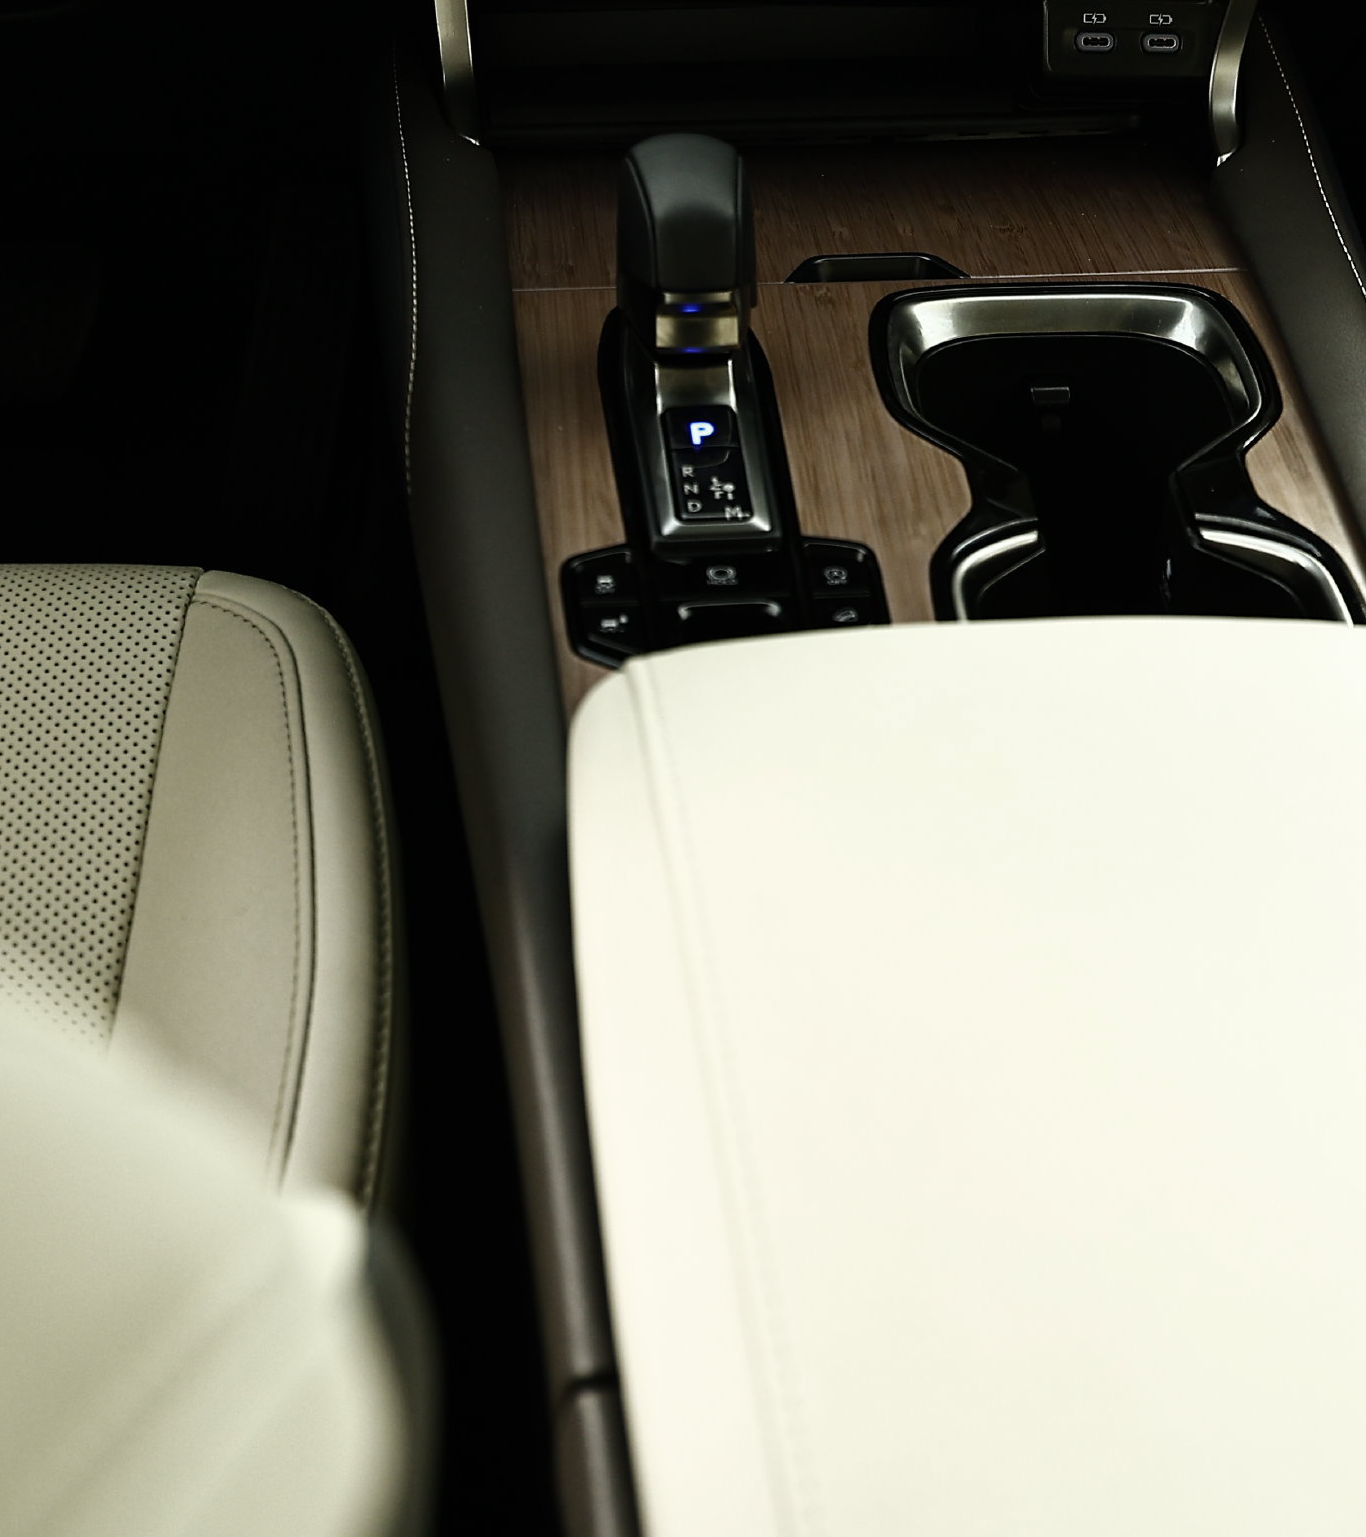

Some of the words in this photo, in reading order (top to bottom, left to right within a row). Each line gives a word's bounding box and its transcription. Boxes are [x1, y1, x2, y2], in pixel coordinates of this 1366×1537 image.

[689, 421, 715, 445] P
[681, 464, 696, 478] R
[683, 482, 700, 496] N
[686, 499, 704, 513] D
